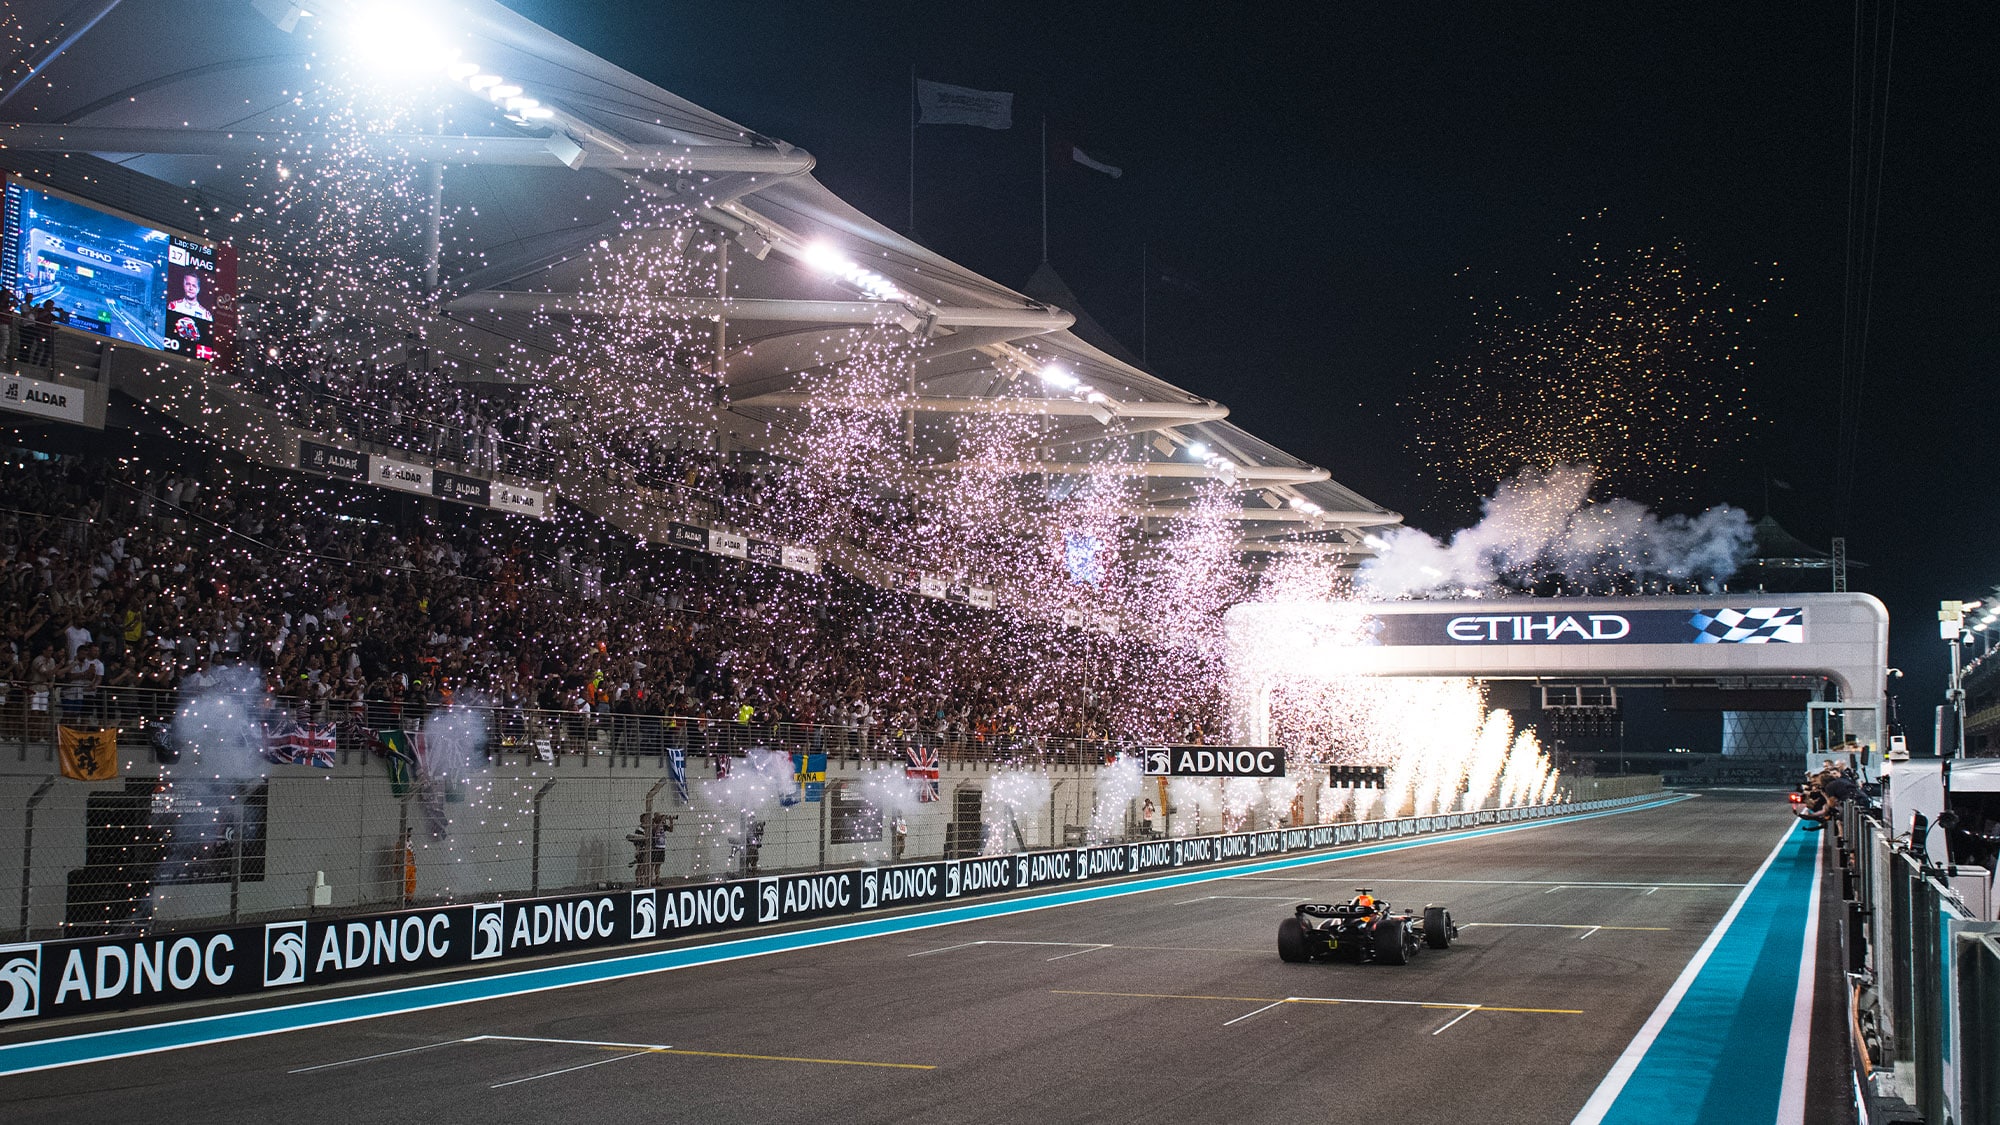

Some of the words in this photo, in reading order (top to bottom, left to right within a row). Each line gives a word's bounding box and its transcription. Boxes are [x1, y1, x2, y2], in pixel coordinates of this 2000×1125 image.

[77, 246, 112, 263] ETIHAD
[174, 238, 189, 250] Lap:
[171, 250, 182, 261] 17
[190, 256, 213, 271] MAG
[164, 337, 180, 350] 20
[26, 389, 66, 408] ALDAR
[327, 455, 358, 471] ALDAR
[395, 471, 421, 484] ALDAR
[456, 483, 480, 496] ALDAR
[1447, 613, 1629, 641] ETIHAD
[1178, 751, 1275, 773] ADNOC
[1184, 839, 1210, 861] ADNOC
[1223, 836, 1247, 857] ADNOC
[1258, 832, 1279, 852] ADNOC
[1089, 847, 1124, 874] ADNOC
[1140, 843, 1170, 867] ADNOC
[963, 859, 1010, 891] ADNOC
[1031, 853, 1070, 882] ADNOC
[783, 874, 851, 913] ADNOC
[882, 867, 938, 901] ADNOC
[662, 886, 745, 930] ADNOC
[1304, 904, 1365, 914] ORACLE
[511, 898, 615, 948] ADNOC
[315, 913, 450, 972] ADNOC
[54, 934, 235, 1005] ADNOC
